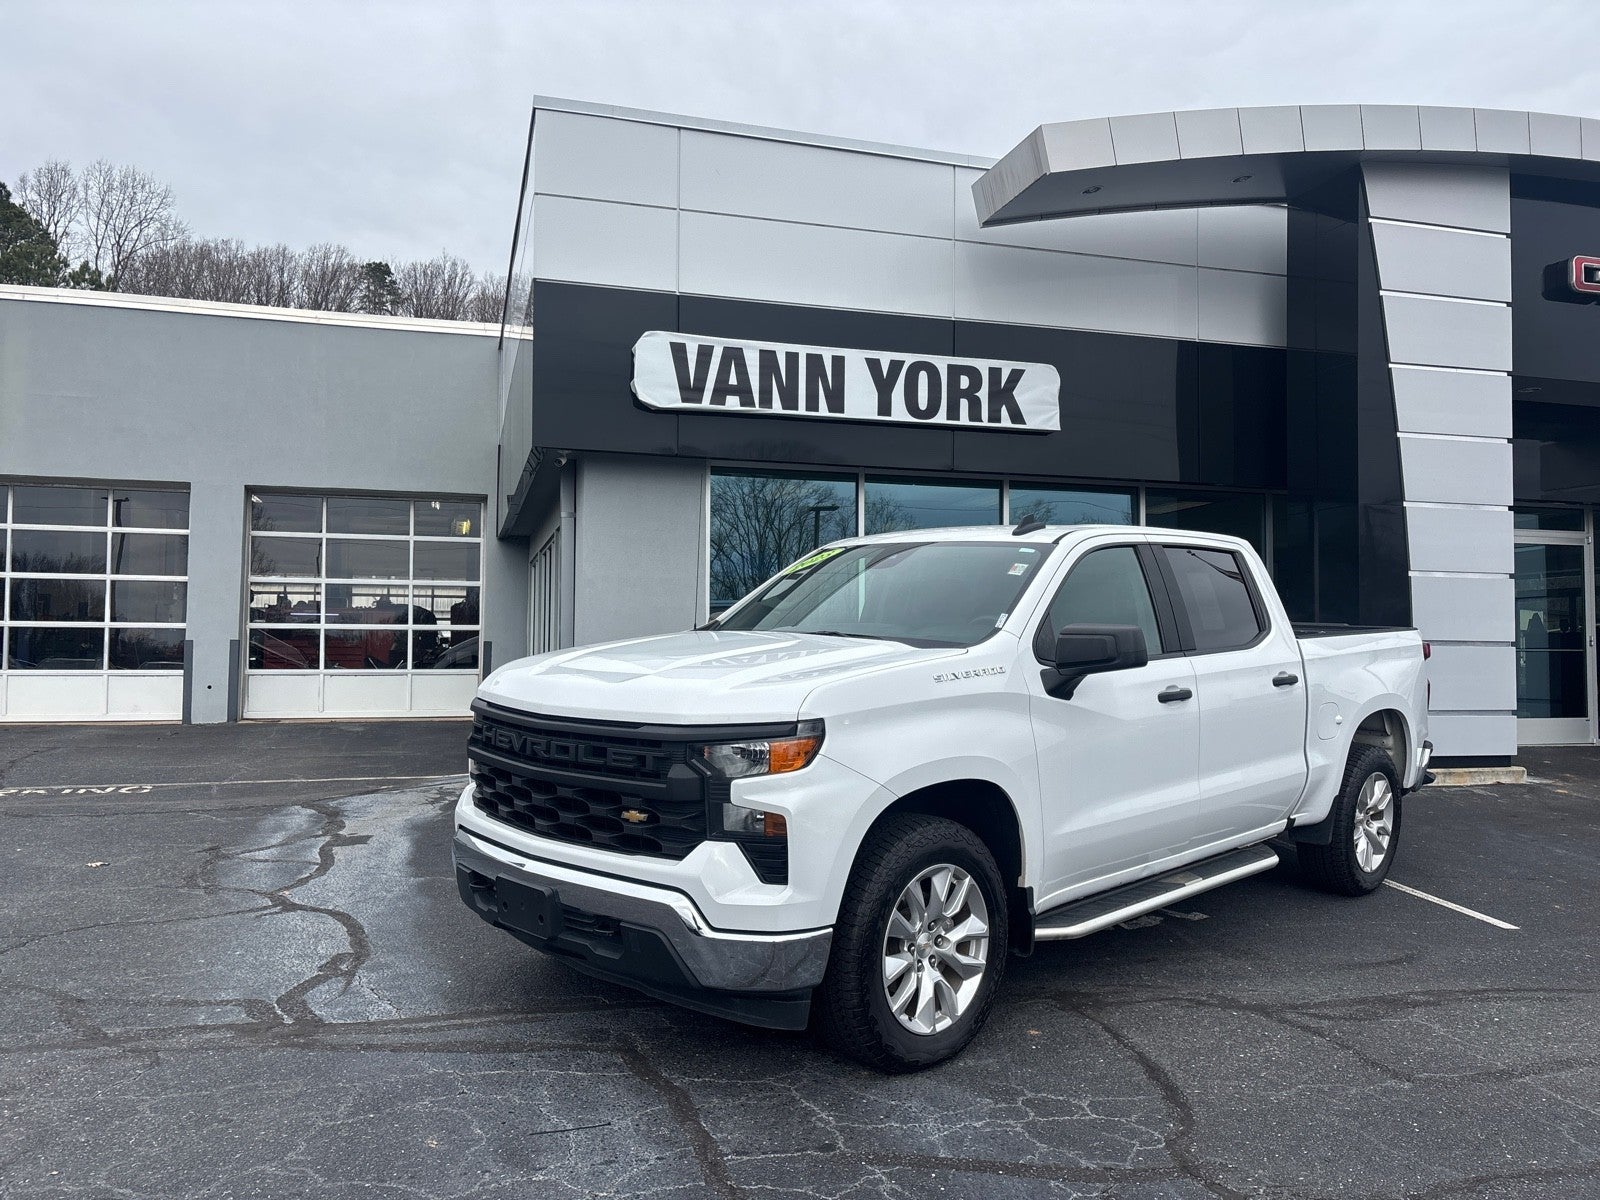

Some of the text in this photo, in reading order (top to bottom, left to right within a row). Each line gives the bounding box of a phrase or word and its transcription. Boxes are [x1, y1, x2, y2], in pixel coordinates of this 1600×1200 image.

[669, 341, 1028, 425] VANN YORK
[932, 665, 1007, 684] SILVERADO
[473, 721, 671, 770] CHEVROLET
